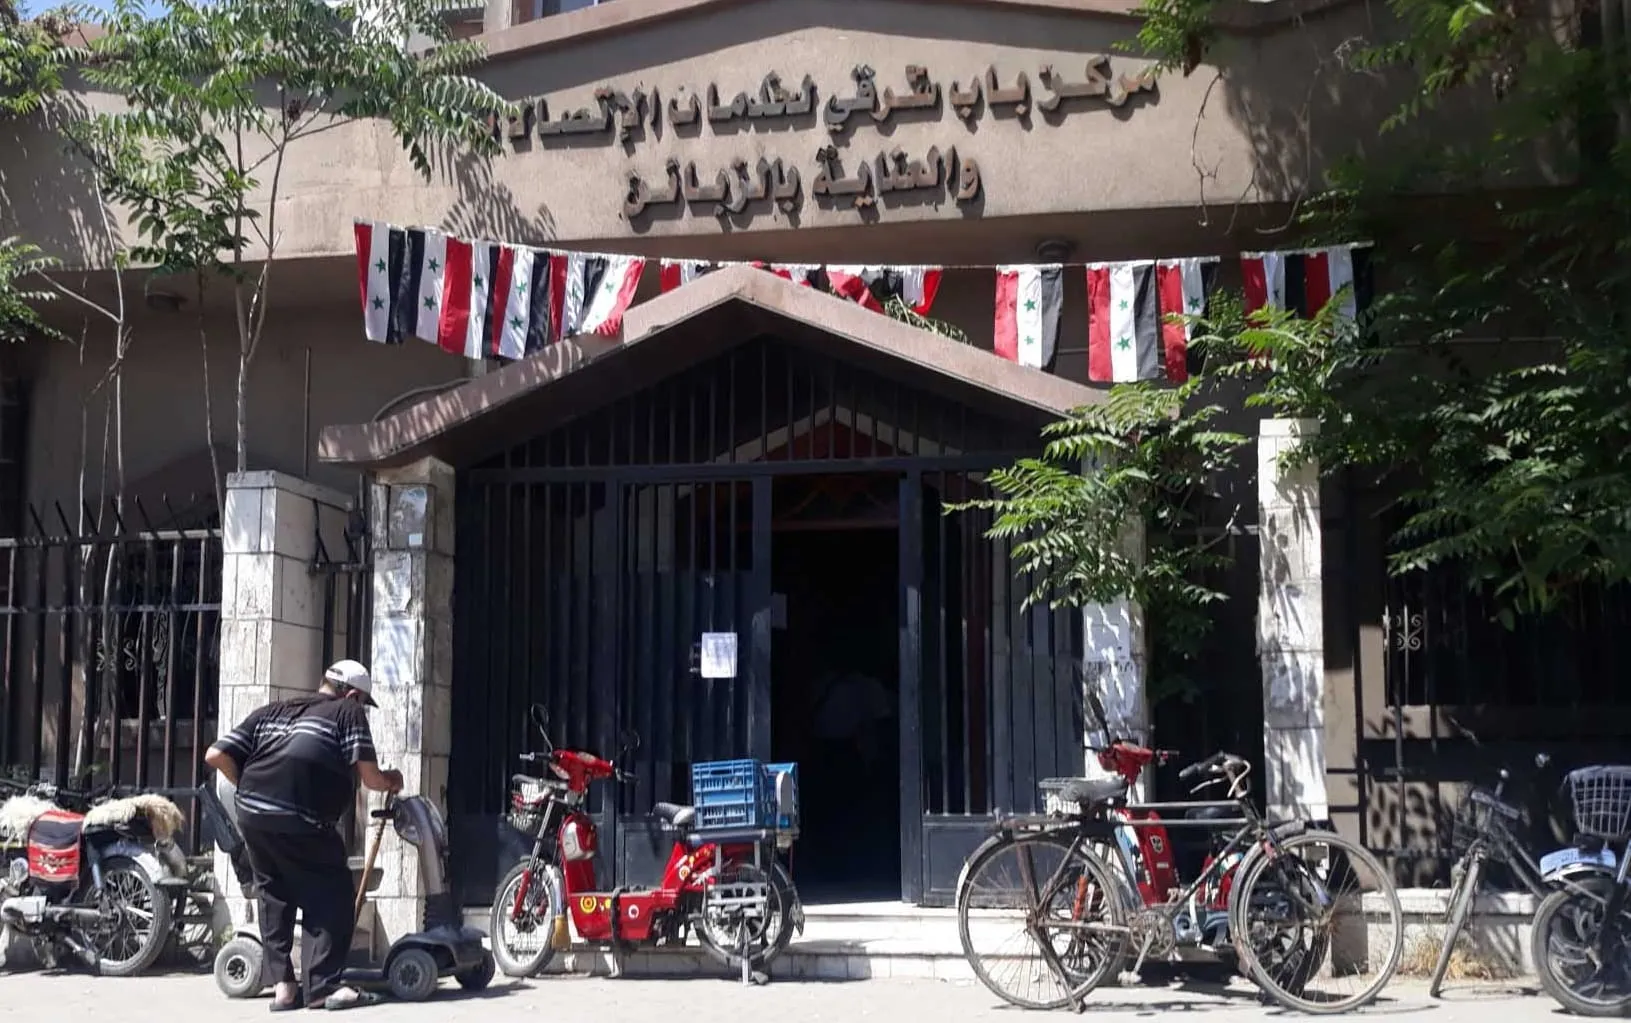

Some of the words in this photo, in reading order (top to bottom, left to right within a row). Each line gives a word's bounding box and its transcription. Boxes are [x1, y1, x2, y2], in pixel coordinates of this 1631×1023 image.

[823, 64, 941, 132] شرقي
[949, 64, 1029, 119] باب
[1037, 54, 1157, 109] مركز
[623, 154, 801, 217] بالزبائن
[812, 144, 981, 207] والعناية
